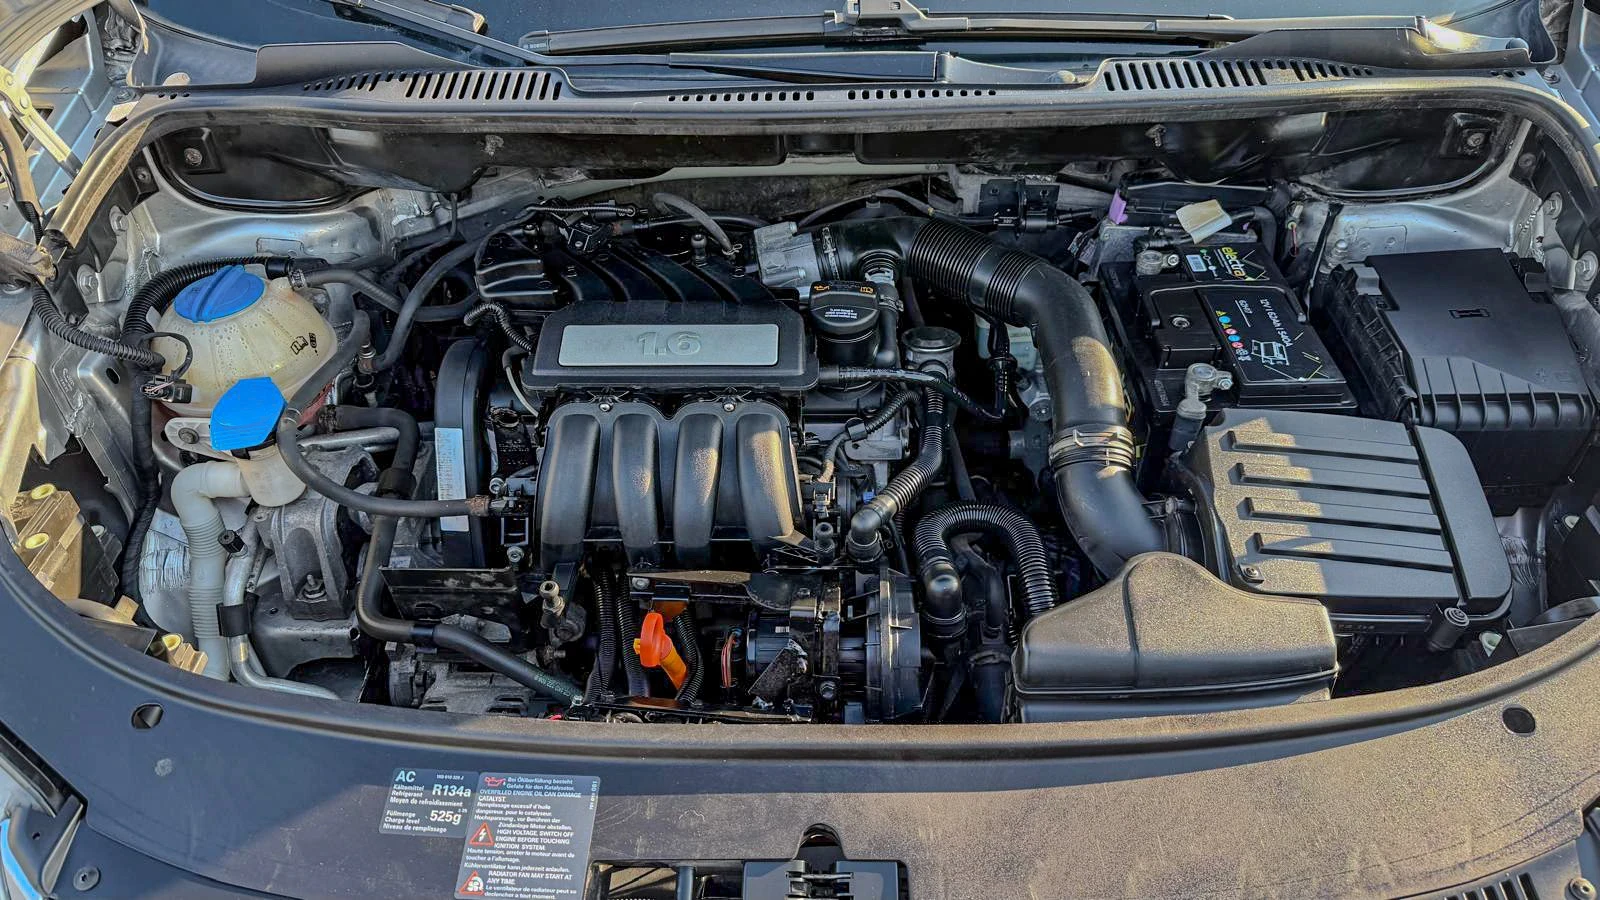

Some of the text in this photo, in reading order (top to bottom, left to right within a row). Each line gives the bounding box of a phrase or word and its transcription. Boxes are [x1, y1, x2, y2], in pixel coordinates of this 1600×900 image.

[1221, 246, 1246, 278] electra
[637, 331, 702, 356] 1.6
[395, 770, 417, 782] AC
[391, 790, 423, 798] Refrigerant
[432, 784, 473, 797] R134a
[419, 798, 463, 807] refroidissement
[386, 810, 416, 818] Füllmenge
[429, 810, 463, 825] 525g
[412, 825, 447, 833] remplissage
